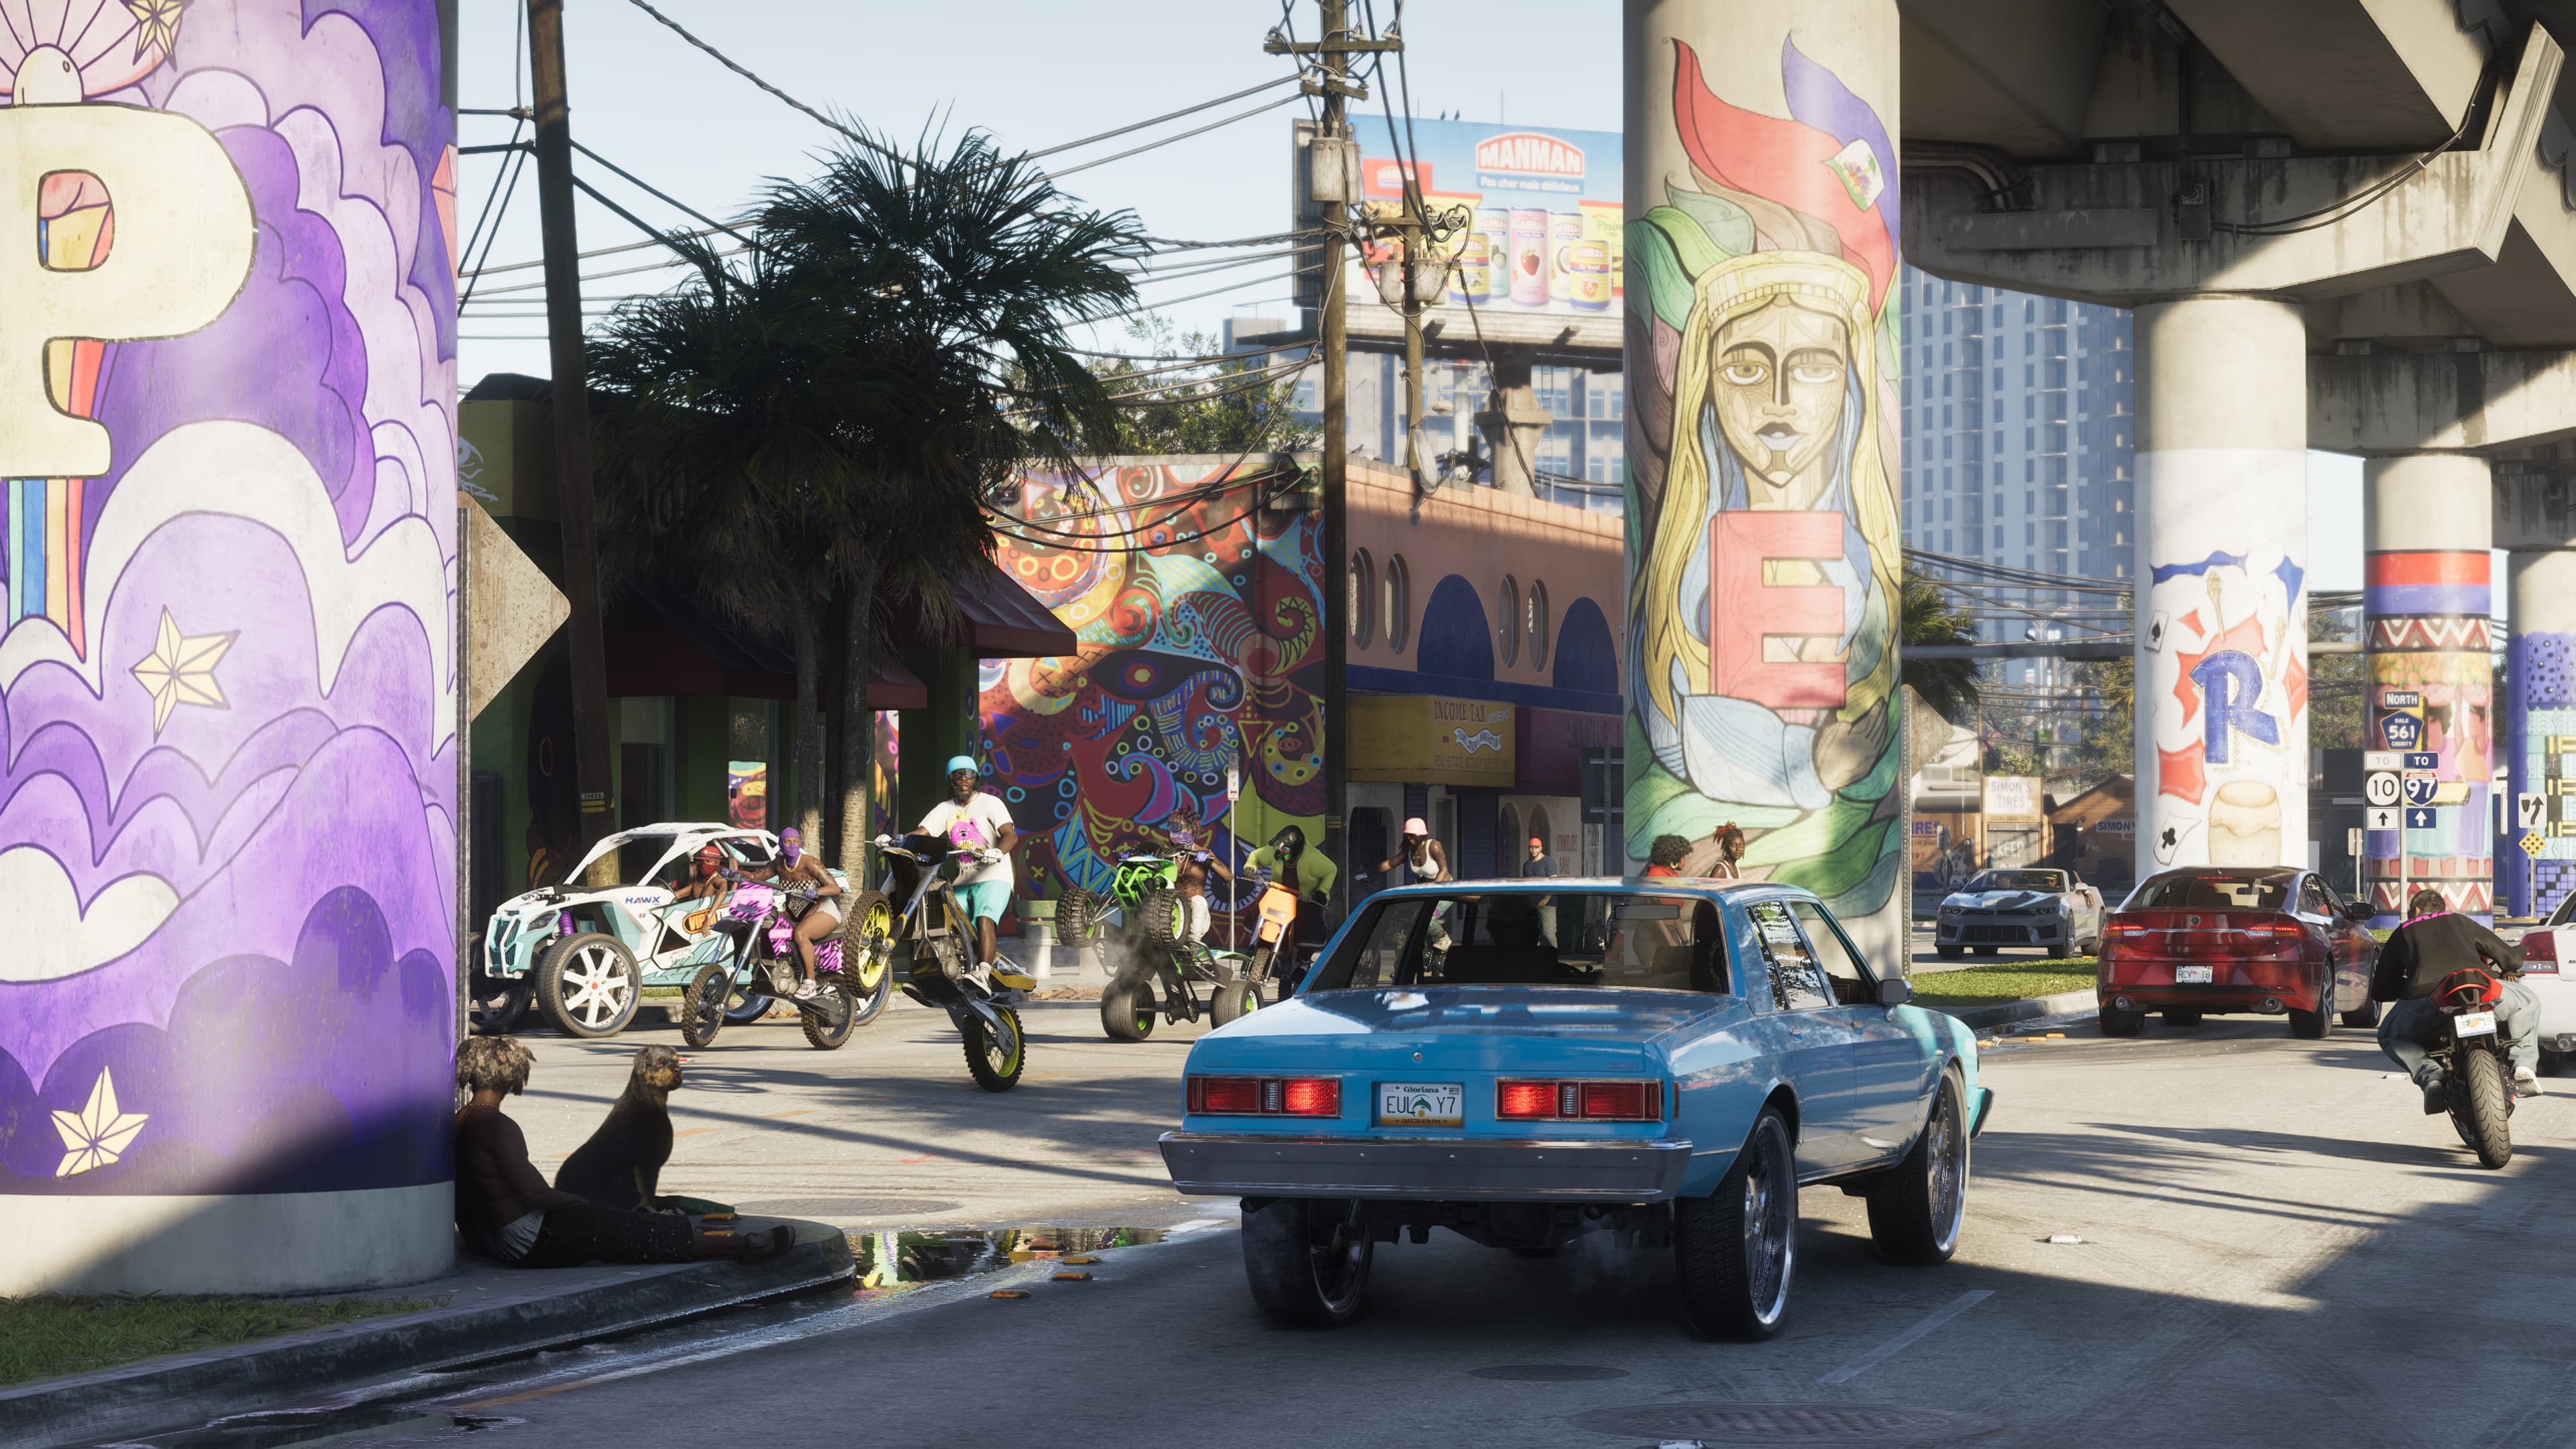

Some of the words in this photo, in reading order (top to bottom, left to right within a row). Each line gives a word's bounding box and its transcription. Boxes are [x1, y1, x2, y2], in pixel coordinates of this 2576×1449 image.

[1479, 138, 1581, 173] MANMAN
[1481, 176, 1497, 187] Pas
[1498, 177, 1518, 189] cher
[1519, 179, 1540, 190] mais
[0, 103, 259, 478] P
[1709, 510, 1847, 708] E
[2190, 649, 2281, 764] R
[2386, 693, 2418, 705] NORTH
[1434, 700, 1467, 721] INCOME
[1470, 702, 1486, 722] TAX
[2389, 724, 2416, 739] 561
[2375, 757, 2390, 765] TO
[2414, 756, 2429, 766] TO
[1990, 780, 2033, 794] SIMON'S
[2373, 780, 2395, 797] 10
[2406, 779, 2436, 799] 97
[1997, 795, 2025, 808] TIRES
[1996, 841, 2024, 859] KEEP
[625, 896, 661, 904] HAWX
[1403, 1085, 1440, 1093] Gloriana
[1387, 1096, 1416, 1114] EUL
[1436, 1096, 1456, 1114] Y7
